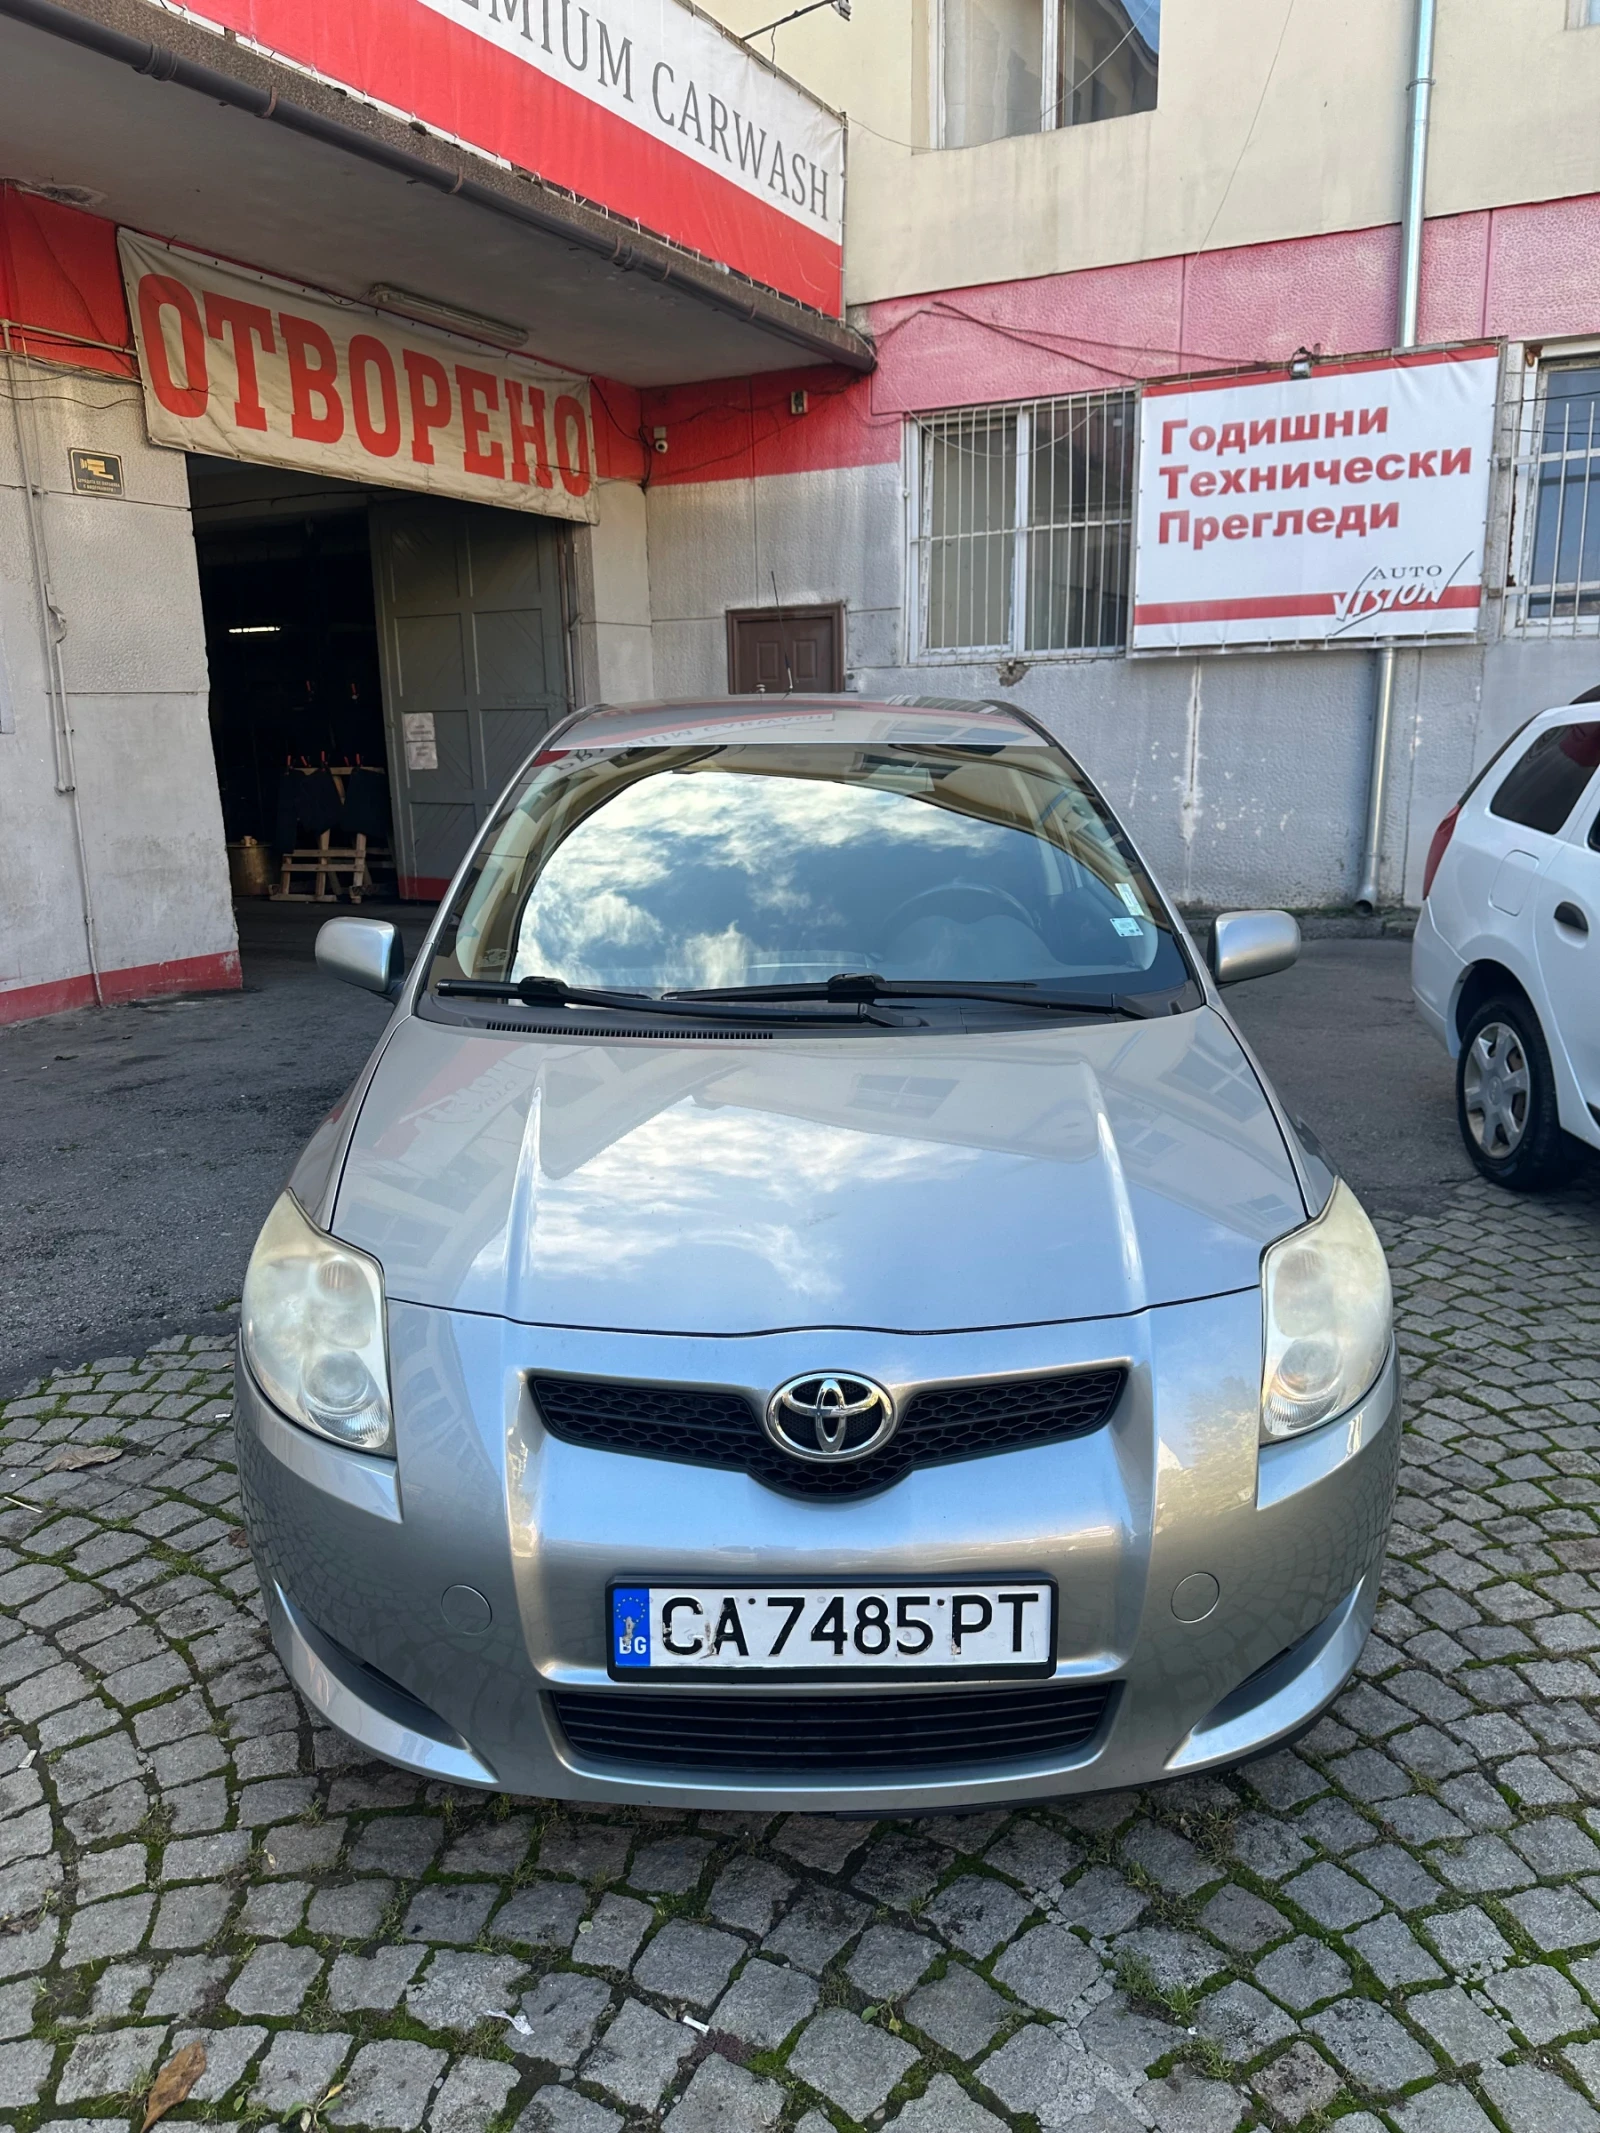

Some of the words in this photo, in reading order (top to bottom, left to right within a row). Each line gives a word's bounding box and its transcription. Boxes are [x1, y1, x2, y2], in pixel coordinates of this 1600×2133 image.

[459, 0, 634, 103] MIUM
[652, 62, 829, 221] CARWASH
[138, 273, 591, 498] ОТВОРЕНО
[1161, 406, 1389, 456] Годишни
[1158, 447, 1472, 500] Технически
[1157, 501, 1400, 550] Прегледи
[1371, 564, 1443, 580] AUTO
[618, 1636, 647, 1654] BG
[661, 1595, 750, 1657] CA
[766, 1595, 934, 1657] 7485
[950, 1592, 1040, 1656] PT
